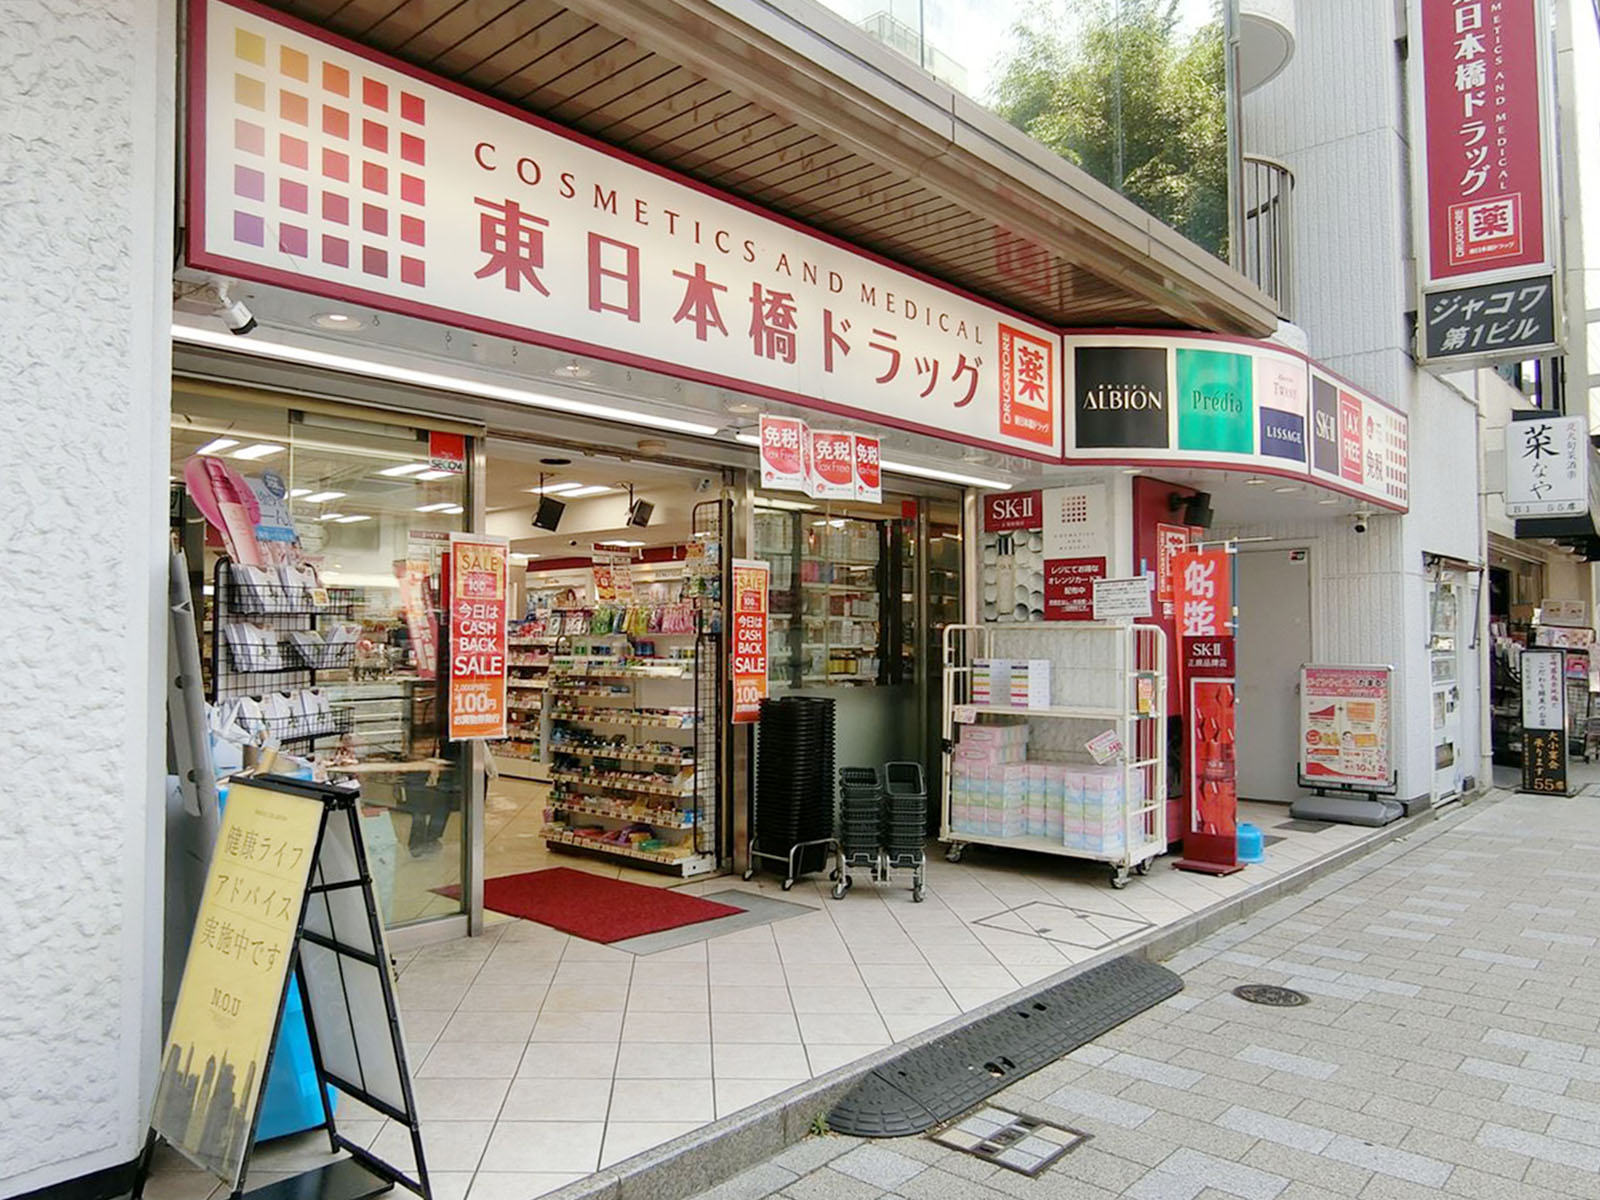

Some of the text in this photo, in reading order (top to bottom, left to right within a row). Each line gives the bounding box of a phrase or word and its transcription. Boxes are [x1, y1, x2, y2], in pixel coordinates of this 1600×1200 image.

[1453, 0, 1491, 196] 日本橋ドラッグ
[1494, 71, 1506, 105] AND
[1495, 113, 1507, 190] MEDICAL
[1473, 205, 1508, 237] 薬
[475, 142, 983, 344] COSMETICS AND MEDICAL
[474, 196, 983, 408] 東日本橋ドラッグ
[1430, 285, 1548, 325] ジャコワ
[1440, 318, 1540, 352] 第1ビル
[1002, 332, 1011, 424] DRUGSTORE
[1018, 346, 1044, 403] 薬
[1192, 390, 1243, 413] Prédia
[1266, 425, 1302, 443] LISSAGE
[1342, 410, 1360, 436] TAX
[764, 425, 799, 449] 免税
[816, 440, 850, 461] 免税
[857, 443, 878, 465] 免税
[1343, 438, 1361, 463] FREE
[431, 459, 463, 471] SECOM
[992, 497, 1033, 520] SK-II
[462, 554, 498, 572] SALE
[459, 604, 498, 619] 今日は
[738, 616, 763, 628] 今日は
[460, 621, 496, 635] CASH
[738, 630, 762, 641] CASH
[460, 637, 497, 652] BACK
[738, 643, 762, 654] BACK
[1192, 643, 1221, 656] SK-II
[454, 656, 502, 676] SALE
[735, 658, 765, 673] SALE
[455, 693, 496, 713] 100円
[224, 826, 303, 871] 健康ライフ
[215, 874, 290, 921] アドバイス
[200, 916, 281, 972] 実施中です
